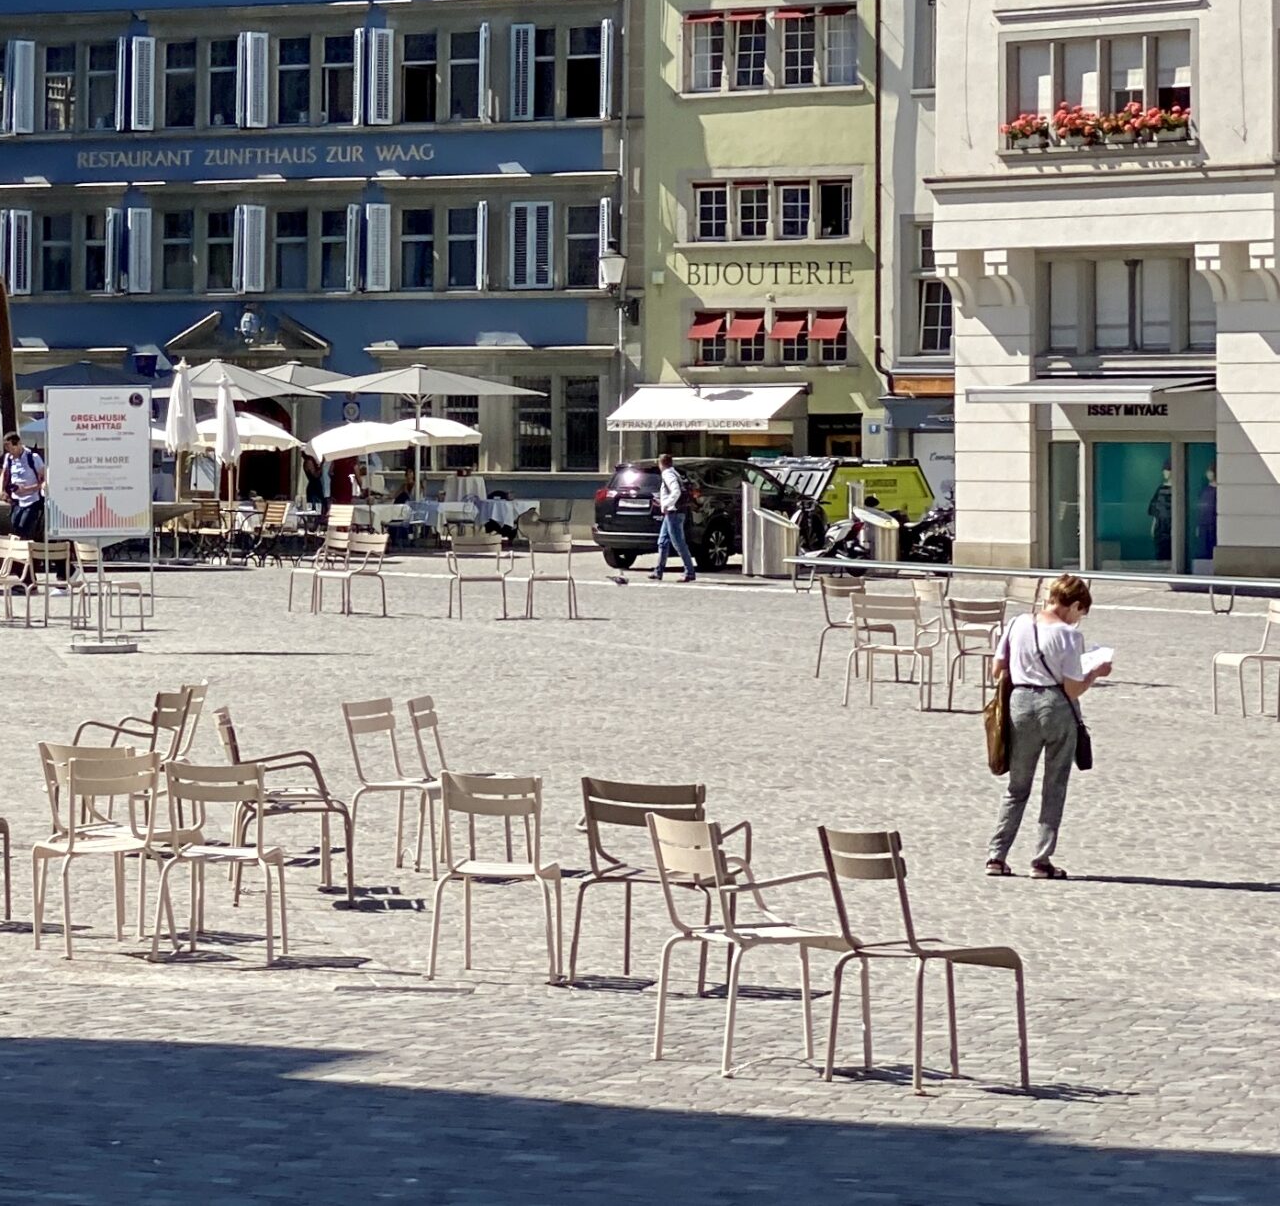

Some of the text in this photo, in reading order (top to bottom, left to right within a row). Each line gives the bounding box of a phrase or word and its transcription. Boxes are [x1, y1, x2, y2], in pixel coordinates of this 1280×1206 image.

[77, 144, 435, 168] RESTAURANT ZUNFTHAUS ZUR WAAG
[687, 261, 854, 286] BIJOUTERIE
[1087, 404, 1168, 416] ISSEY MIYAKE
[70, 414, 127, 422] ORGELMUSIK
[75, 422, 122, 430] AM MITTAG
[622, 420, 752, 429] FRANZ MARFURT LUCERNE
[68, 456, 92, 464] BACH
[105, 456, 130, 464] MORE
